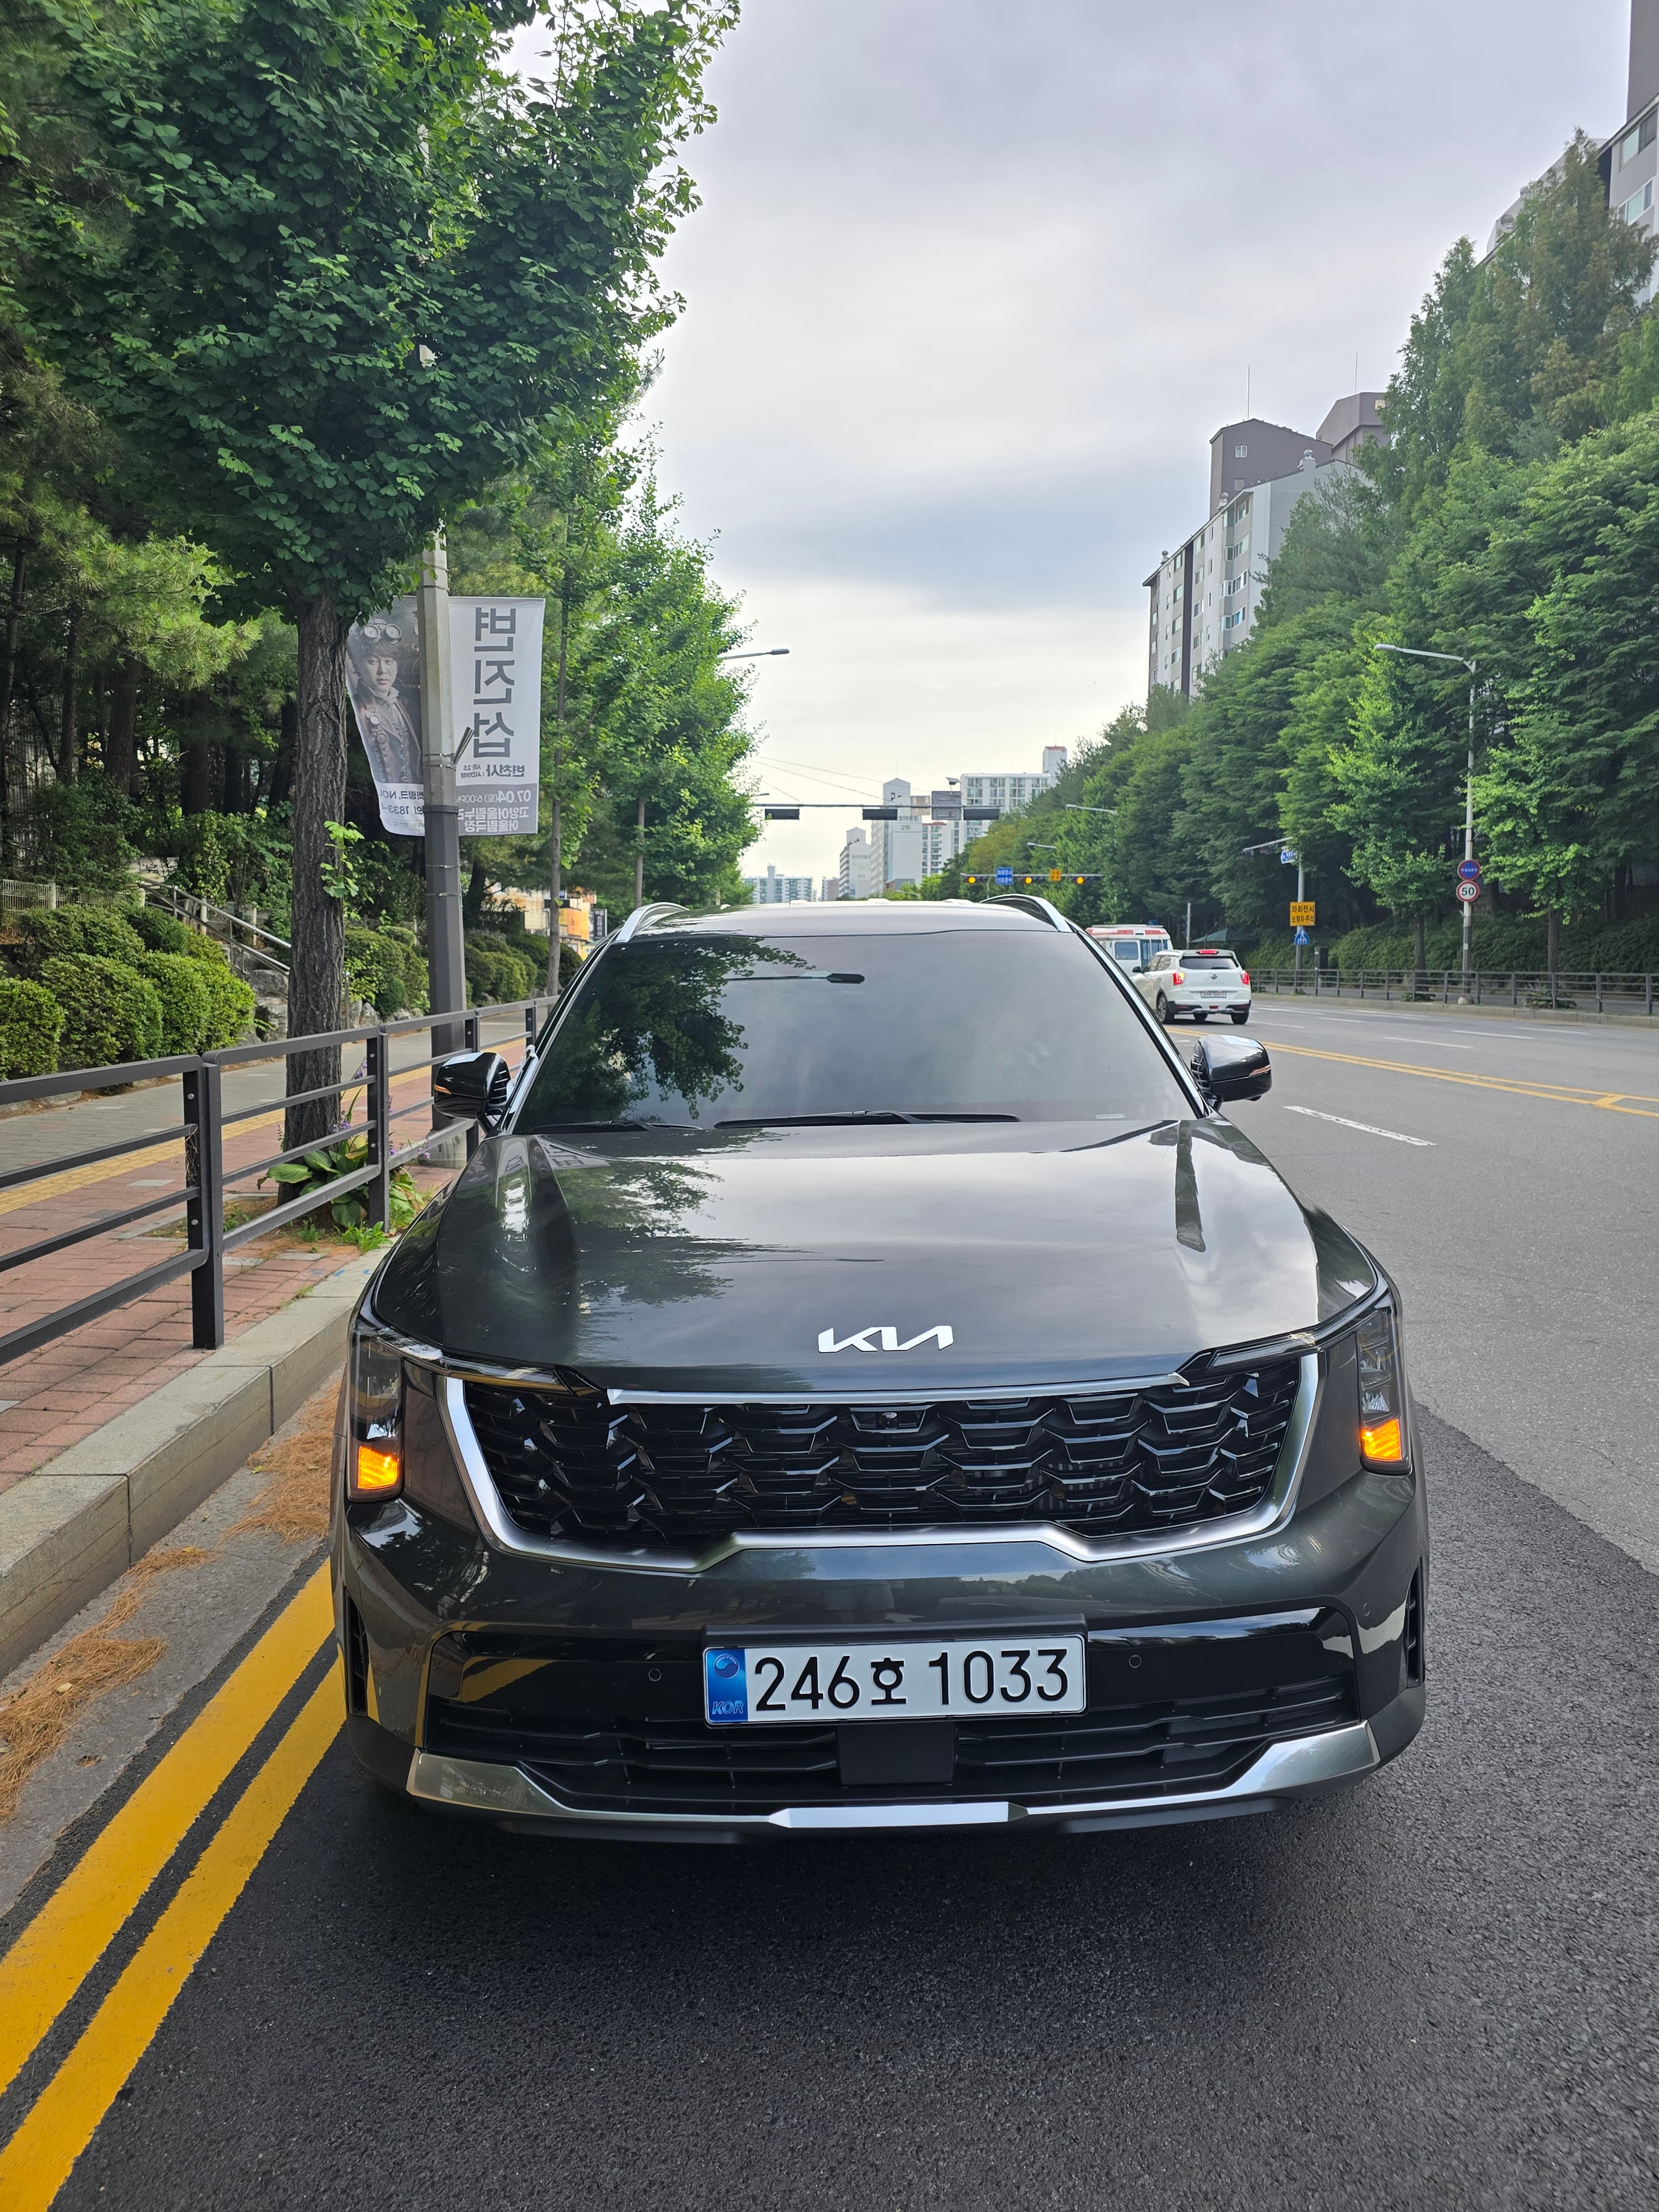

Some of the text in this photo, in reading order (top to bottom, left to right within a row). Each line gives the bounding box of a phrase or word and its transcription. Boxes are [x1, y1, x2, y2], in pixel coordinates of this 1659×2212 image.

[1462, 887, 1474, 896] 50
[1291, 905, 1314, 913] 좌회전시
[754, 1648, 1069, 1712] 246호 1033
[712, 1700, 744, 1714] KOR
